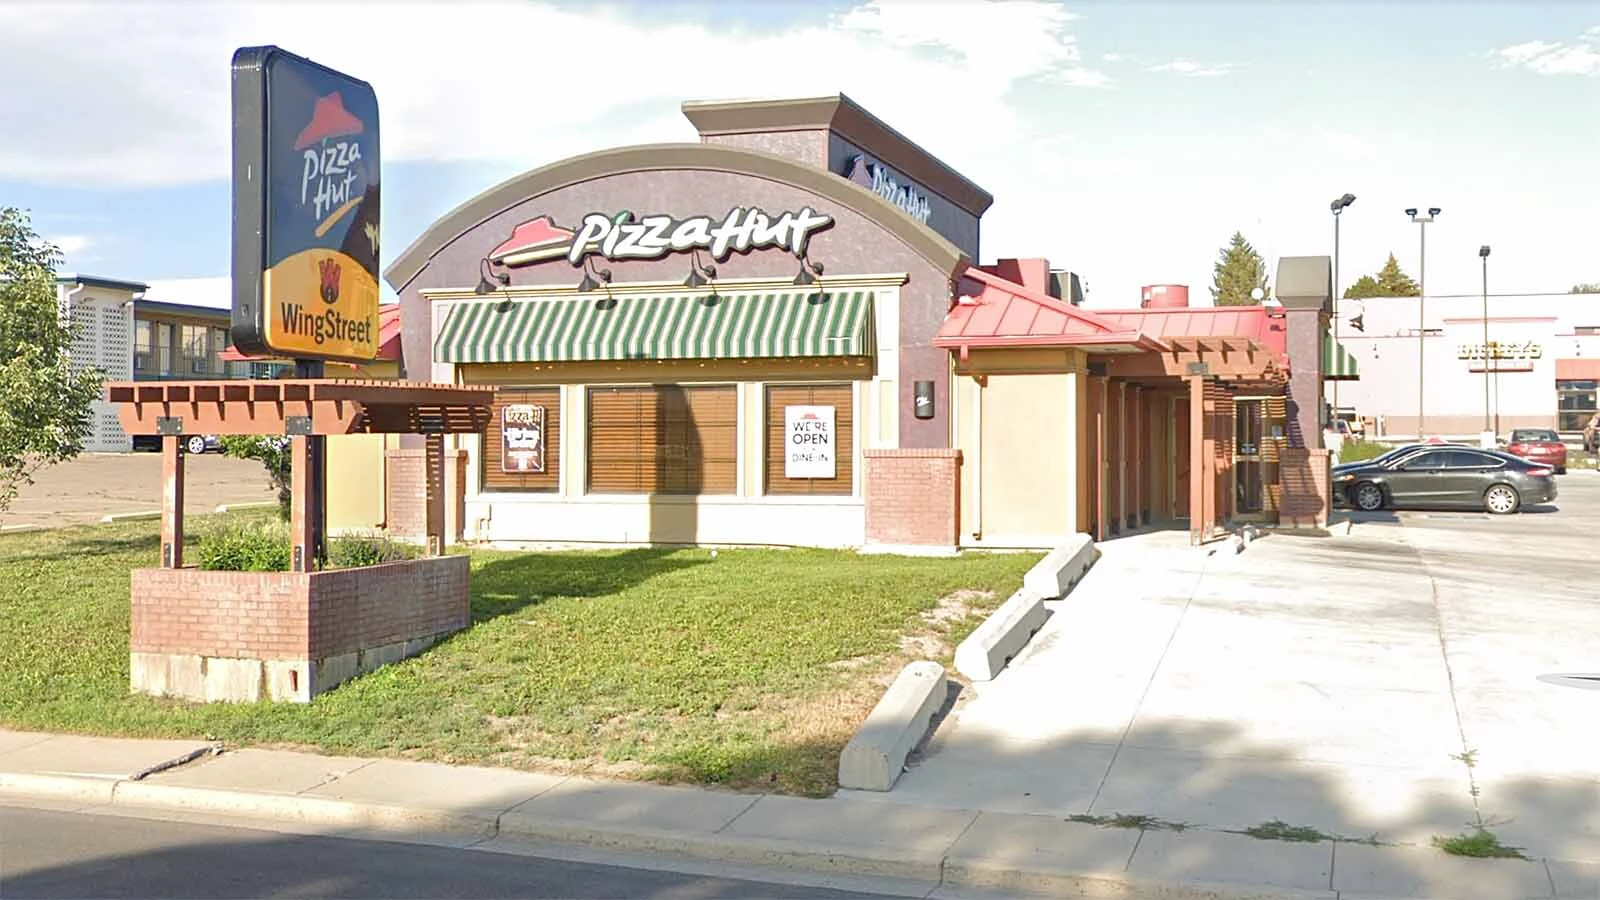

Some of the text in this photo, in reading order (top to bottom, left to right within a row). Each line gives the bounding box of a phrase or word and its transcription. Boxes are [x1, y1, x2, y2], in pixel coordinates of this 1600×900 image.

[302, 137, 362, 204] Pizza
[313, 173, 357, 220] Hut
[568, 206, 834, 265] Pizza Hut
[281, 302, 371, 344] WingStreet
[792, 433, 828, 445] OPEN
